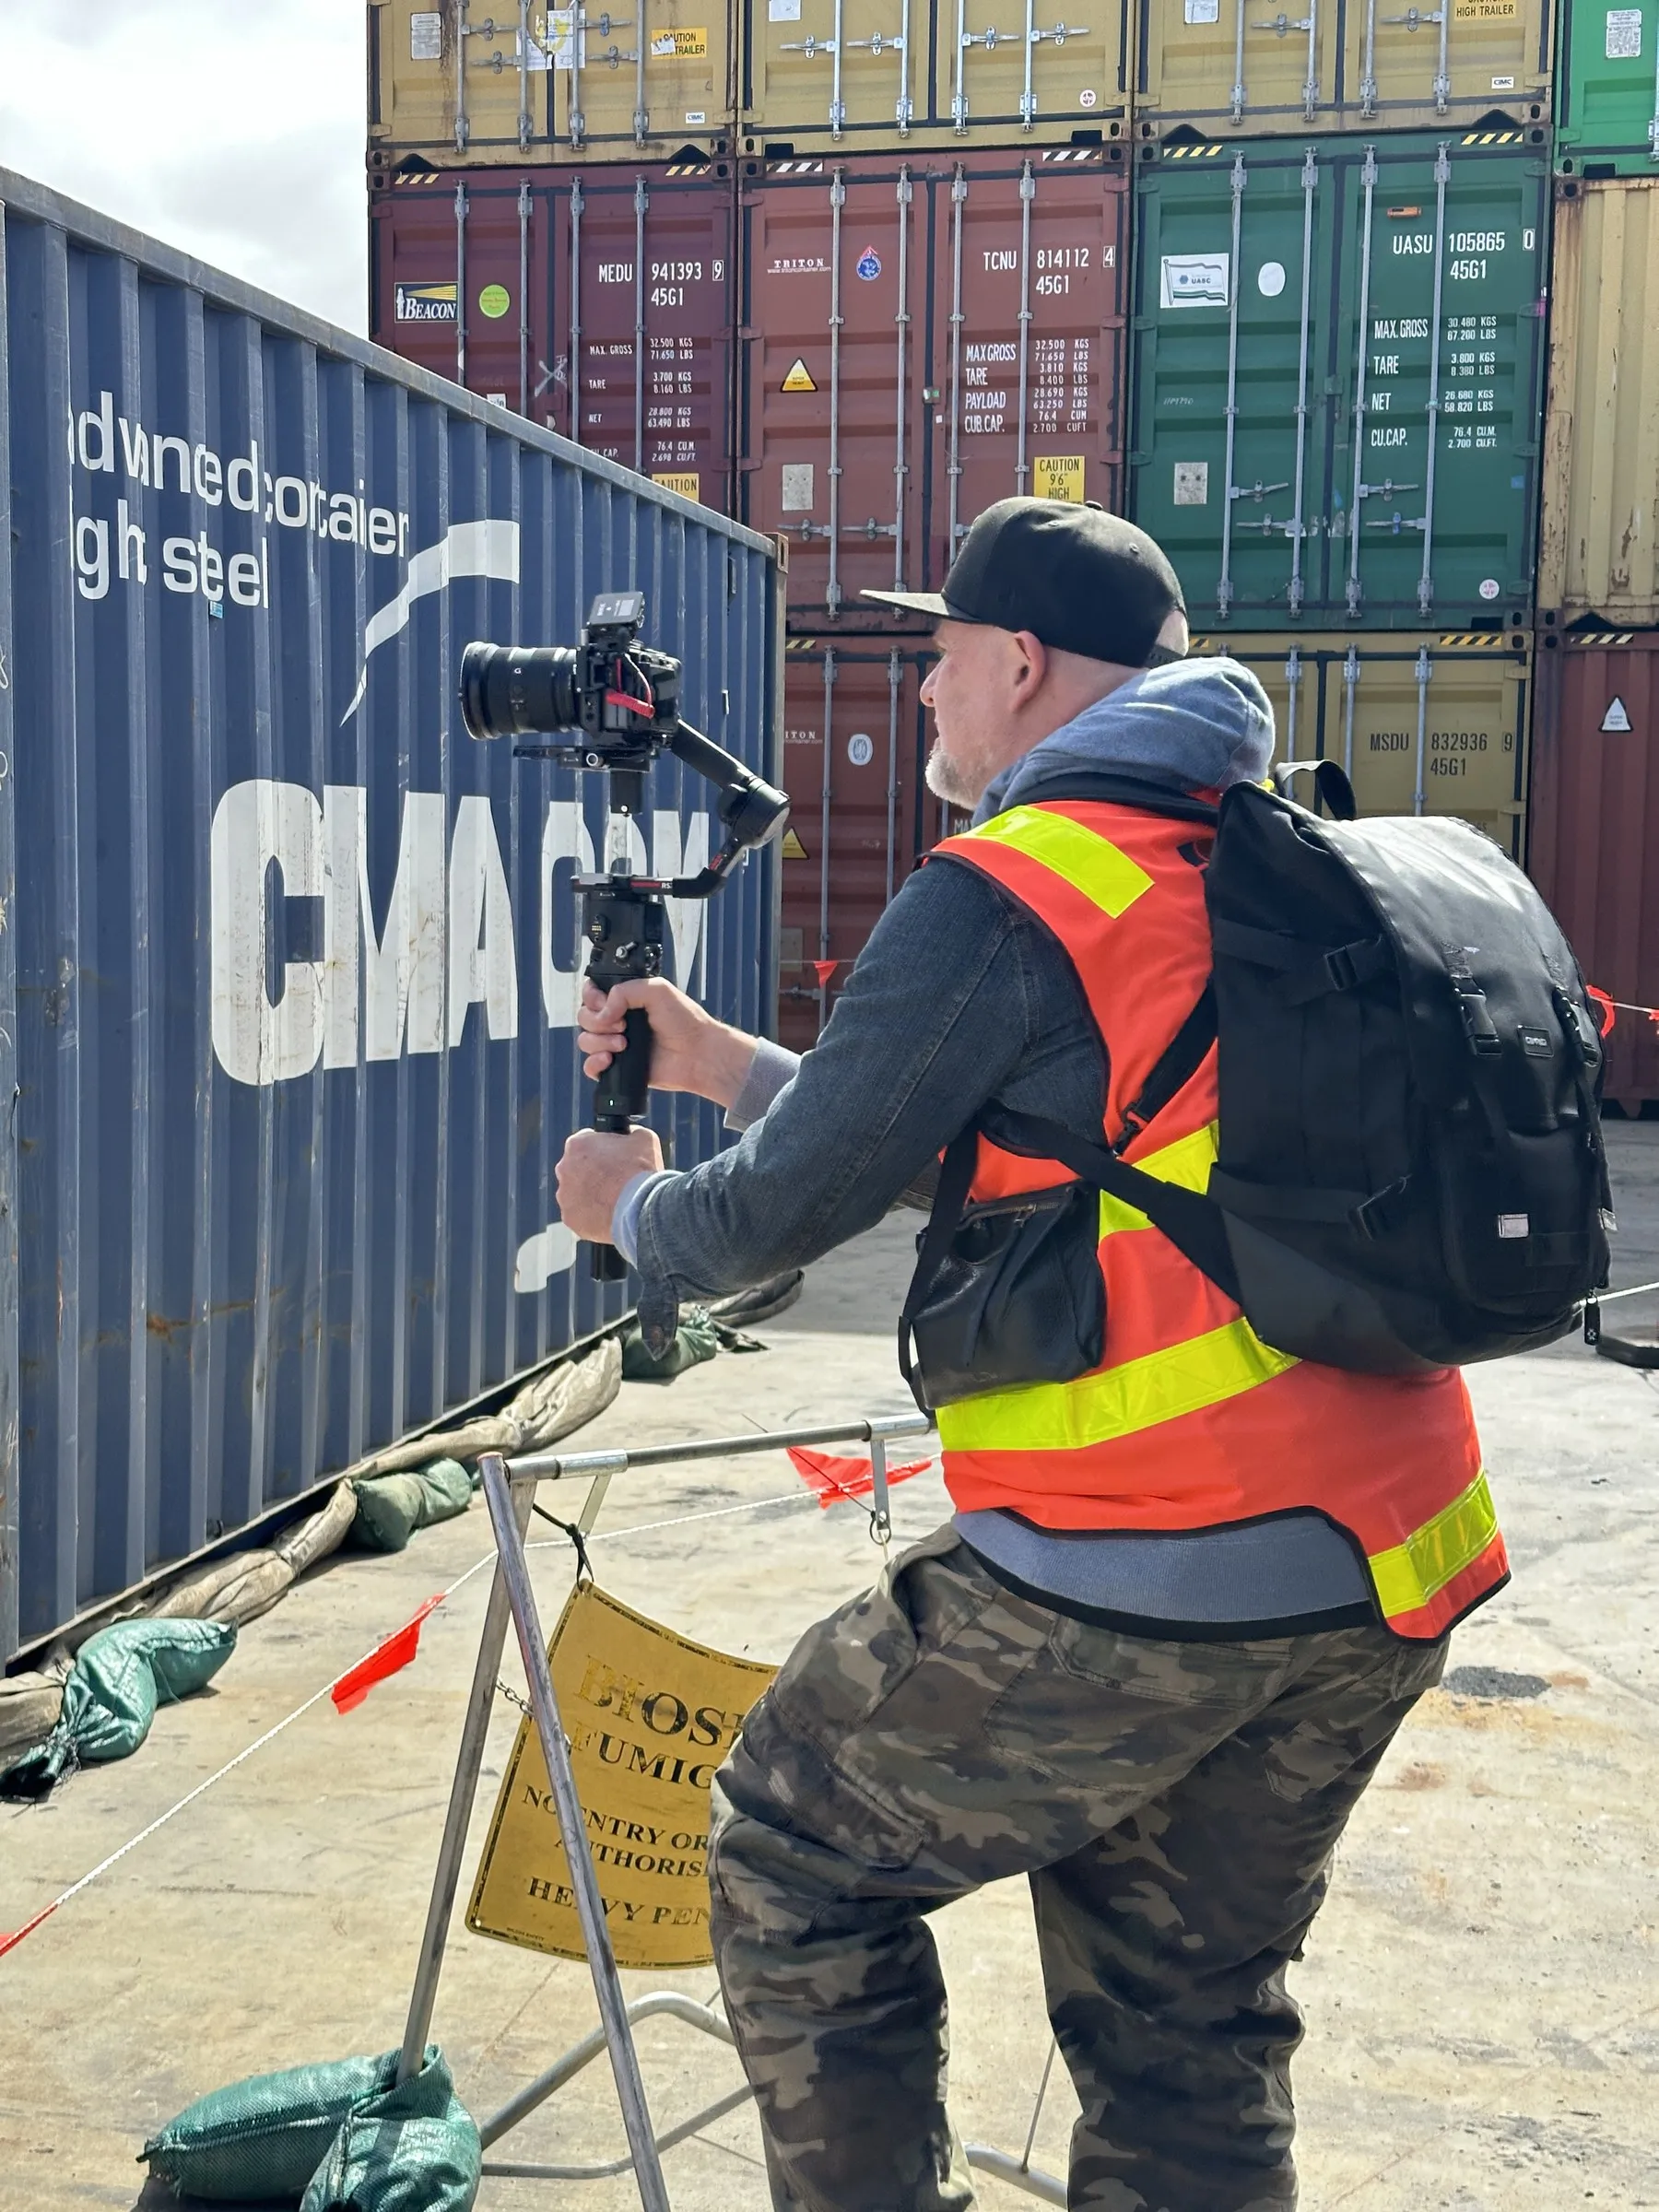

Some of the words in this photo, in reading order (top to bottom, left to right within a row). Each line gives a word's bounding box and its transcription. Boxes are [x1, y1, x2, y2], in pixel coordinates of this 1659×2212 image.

[1456, 6, 1476, 17] HIGH
[1480, 5, 1514, 16] TRAILER
[675, 44, 705, 55] TRAILER
[1393, 235, 1432, 254] UASU
[1449, 232, 1505, 253] 105865
[1524, 229, 1534, 250] 0
[774, 258, 824, 268] TRITON
[983, 251, 1017, 271] TCNU
[1037, 249, 1089, 268] 814112
[1103, 247, 1114, 267] 4
[598, 264, 633, 282] MEDU
[652, 262, 702, 280] 941393
[713, 261, 724, 280] 9
[1451, 259, 1487, 279] 45G1
[1036, 275, 1069, 295] 45G1
[651, 288, 684, 306] 45G1
[405, 298, 456, 320] BEACON
[1374, 320, 1398, 339] MAX.
[1400, 319, 1428, 338] GROSS
[1481, 316, 1497, 326] KGS
[1480, 329, 1496, 339] LBS
[610, 345, 633, 355] GROSS
[650, 337, 674, 348] 32.500
[679, 337, 693, 347] KGS
[651, 350, 675, 360] 71.650
[679, 349, 693, 359] LBS
[988, 344, 1017, 360] GROSS
[1035, 339, 1065, 350] 32.500
[1075, 338, 1089, 348] KGS
[1035, 352, 1065, 362] 71.650
[1074, 351, 1088, 360] LBS
[1373, 356, 1399, 375] TARE
[1479, 352, 1495, 362] KGS
[966, 367, 988, 386] TARE
[1040, 363, 1064, 373] 3.810
[1073, 362, 1088, 372] KGS
[1073, 374, 1088, 384] LBS
[1479, 365, 1495, 375] LBS
[589, 379, 606, 390] TARE
[653, 371, 673, 382] 3.700
[677, 371, 692, 382] KGS
[678, 383, 692, 394] LBS
[965, 392, 1006, 410] PAYLOAD
[1073, 387, 1088, 397] KGS
[1072, 399, 1088, 408] LBS
[1371, 393, 1391, 411] NET
[1477, 390, 1493, 399] KGS
[1477, 401, 1493, 411] LBS
[588, 414, 602, 423] NET
[677, 406, 692, 416] KGS
[677, 418, 690, 428] LBS
[965, 415, 1006, 433] CUB.CAP.
[1039, 411, 1057, 421] 76.4
[1033, 423, 1057, 433] 2.700
[1066, 422, 1087, 432] CUFT
[1371, 428, 1407, 446] CU.CAP.
[1448, 440, 1471, 449] 2.700
[604, 448, 618, 458] CAP.
[657, 441, 673, 452] 76.4
[1039, 458, 1080, 472] CAUTION
[1048, 487, 1069, 500] HIGH
[785, 731, 816, 739] ITON
[1370, 734, 1409, 751] MSDU
[1431, 733, 1488, 751] 832936
[1504, 733, 1513, 752] 9
[1430, 758, 1466, 776] 45G1
[954, 818, 971, 834] MA
[570, 1720, 719, 1790] FUMIG
[555, 1839, 710, 1878] THORIS
[528, 1876, 645, 1922] HEVY
[653, 1906, 711, 1925] PEN
